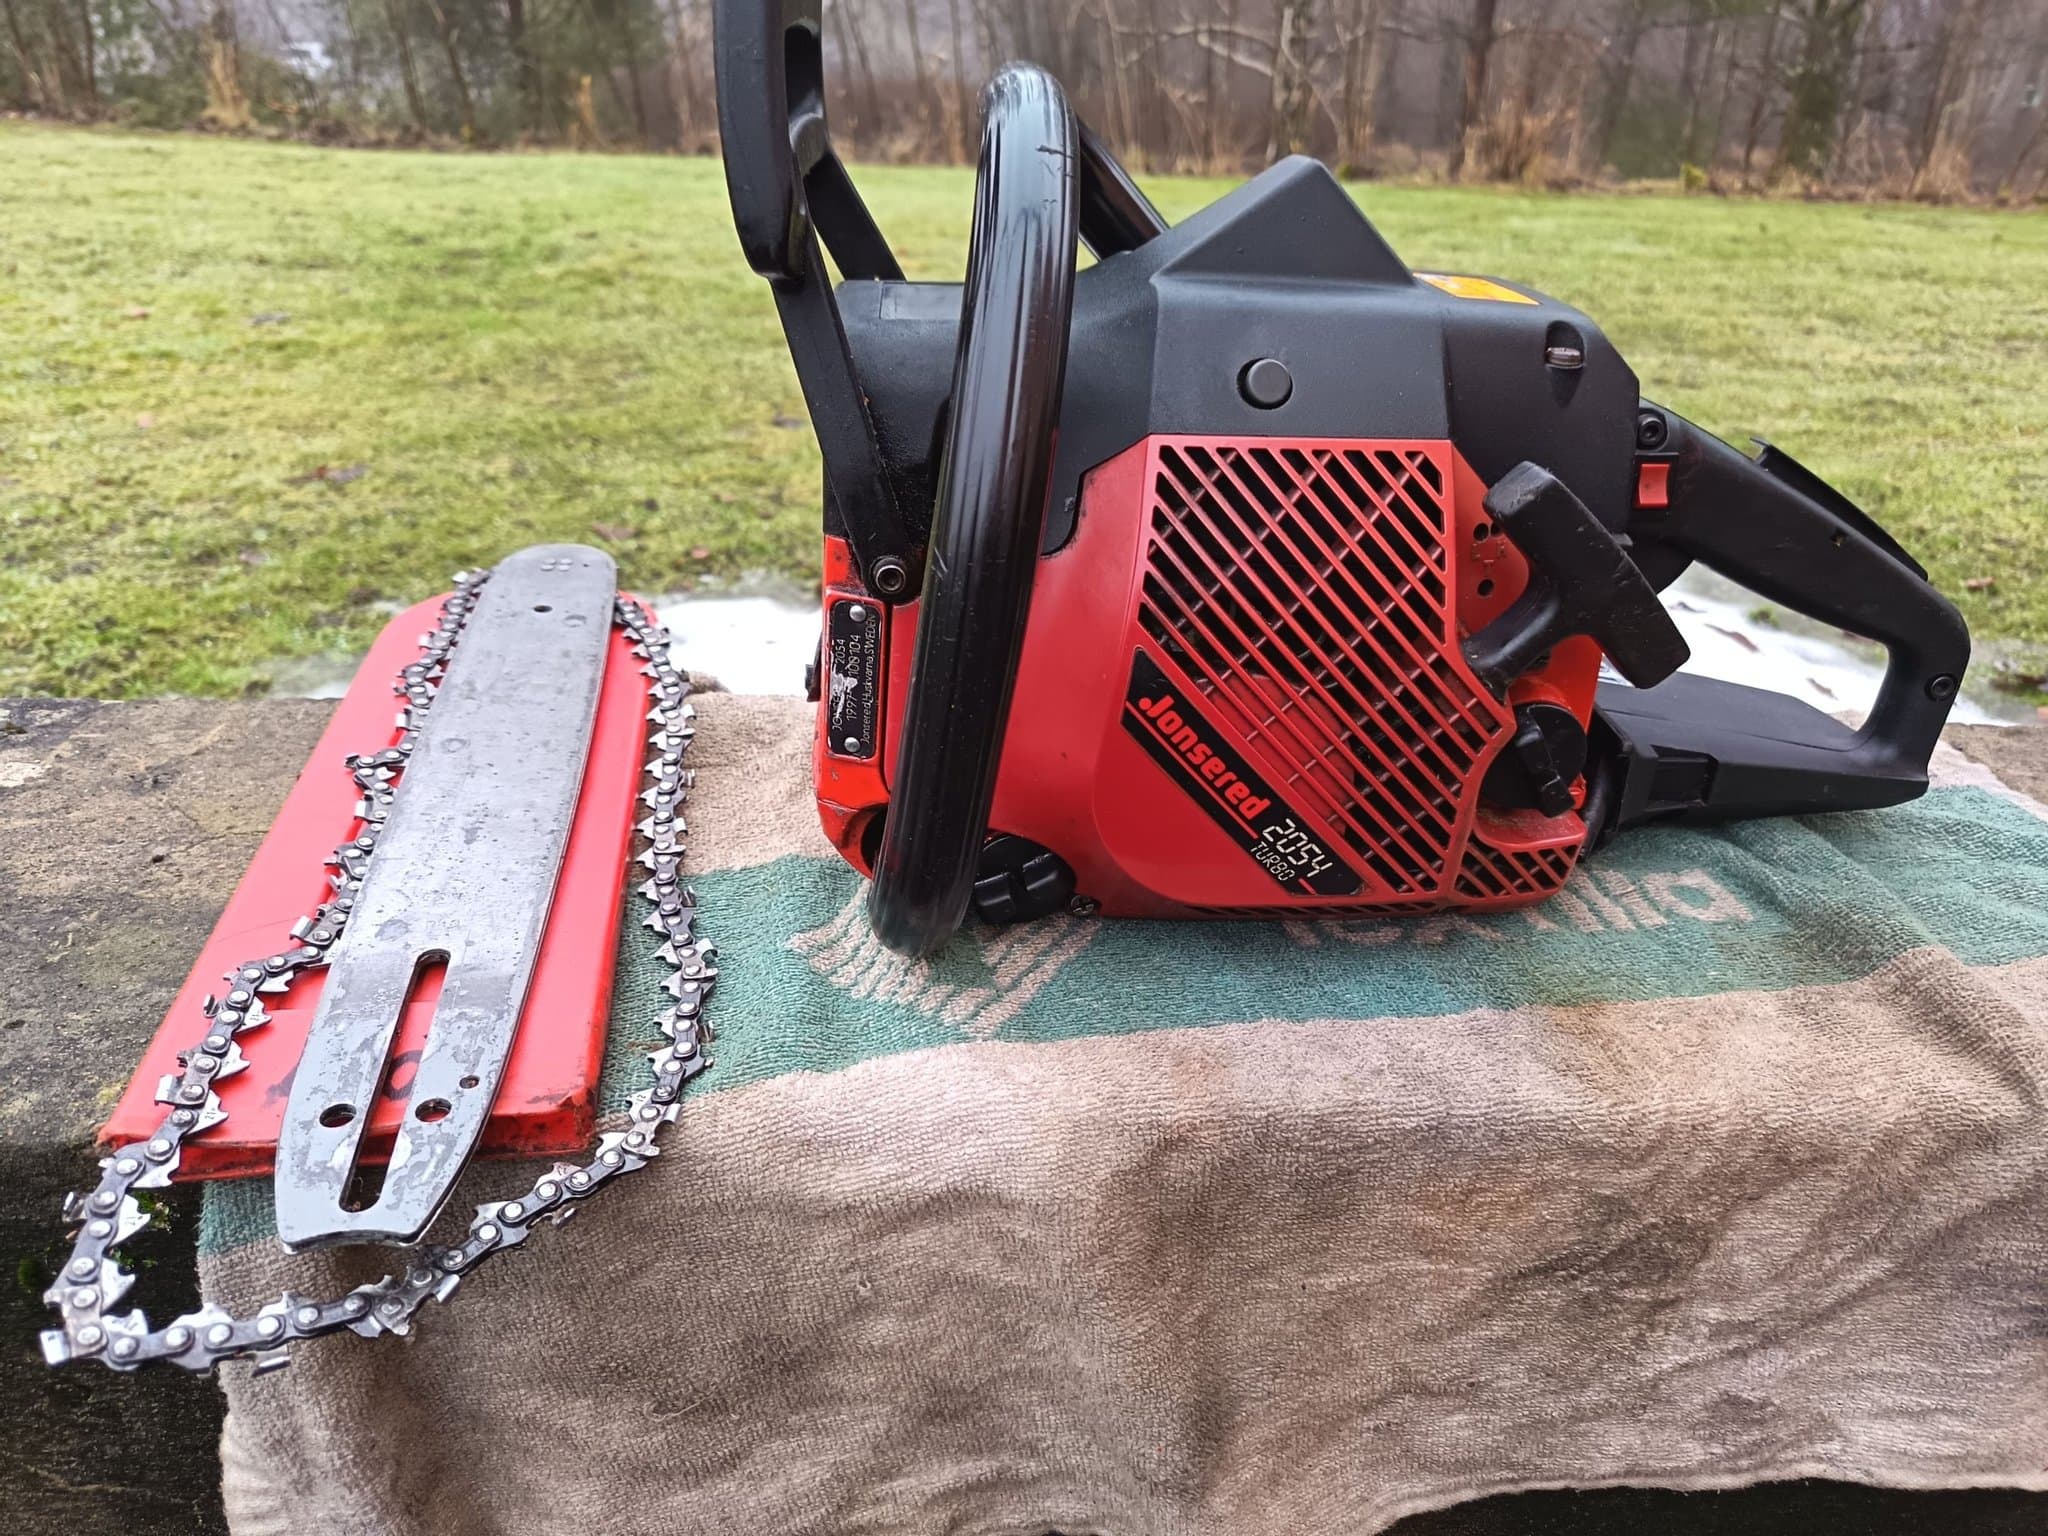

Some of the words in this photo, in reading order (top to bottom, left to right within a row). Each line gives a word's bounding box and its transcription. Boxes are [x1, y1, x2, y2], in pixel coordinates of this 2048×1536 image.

[835, 638, 846, 665] 2054
[1138, 695, 1271, 820] Jonsered
[1250, 841, 1296, 881] TURBO
[1262, 818, 1333, 878] 2054
